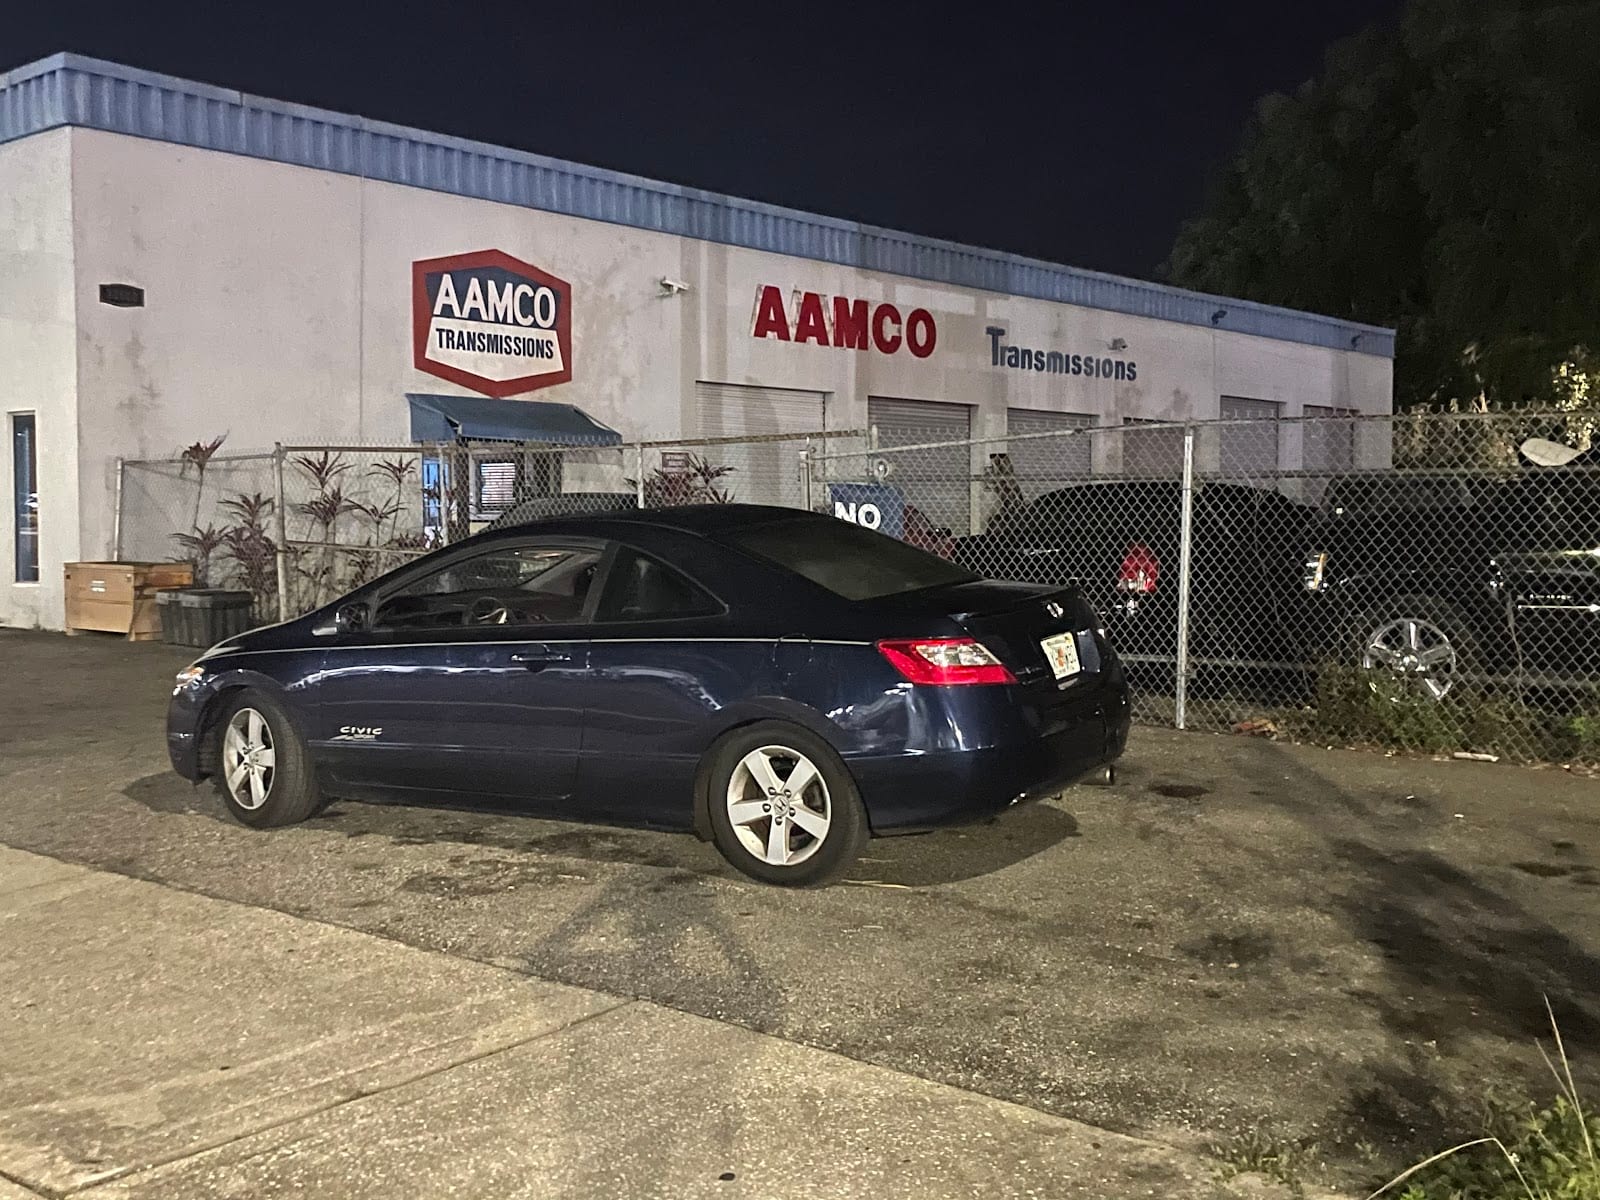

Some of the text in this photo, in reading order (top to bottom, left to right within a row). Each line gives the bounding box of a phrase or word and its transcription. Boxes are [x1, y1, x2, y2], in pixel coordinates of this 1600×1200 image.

[433, 273, 556, 329] AAMCO
[436, 328, 554, 359] TRANSMISSIONS
[753, 285, 1137, 381] AAMCO Transmissions
[834, 501, 881, 530] NO
[340, 726, 383, 735] CIVIC
